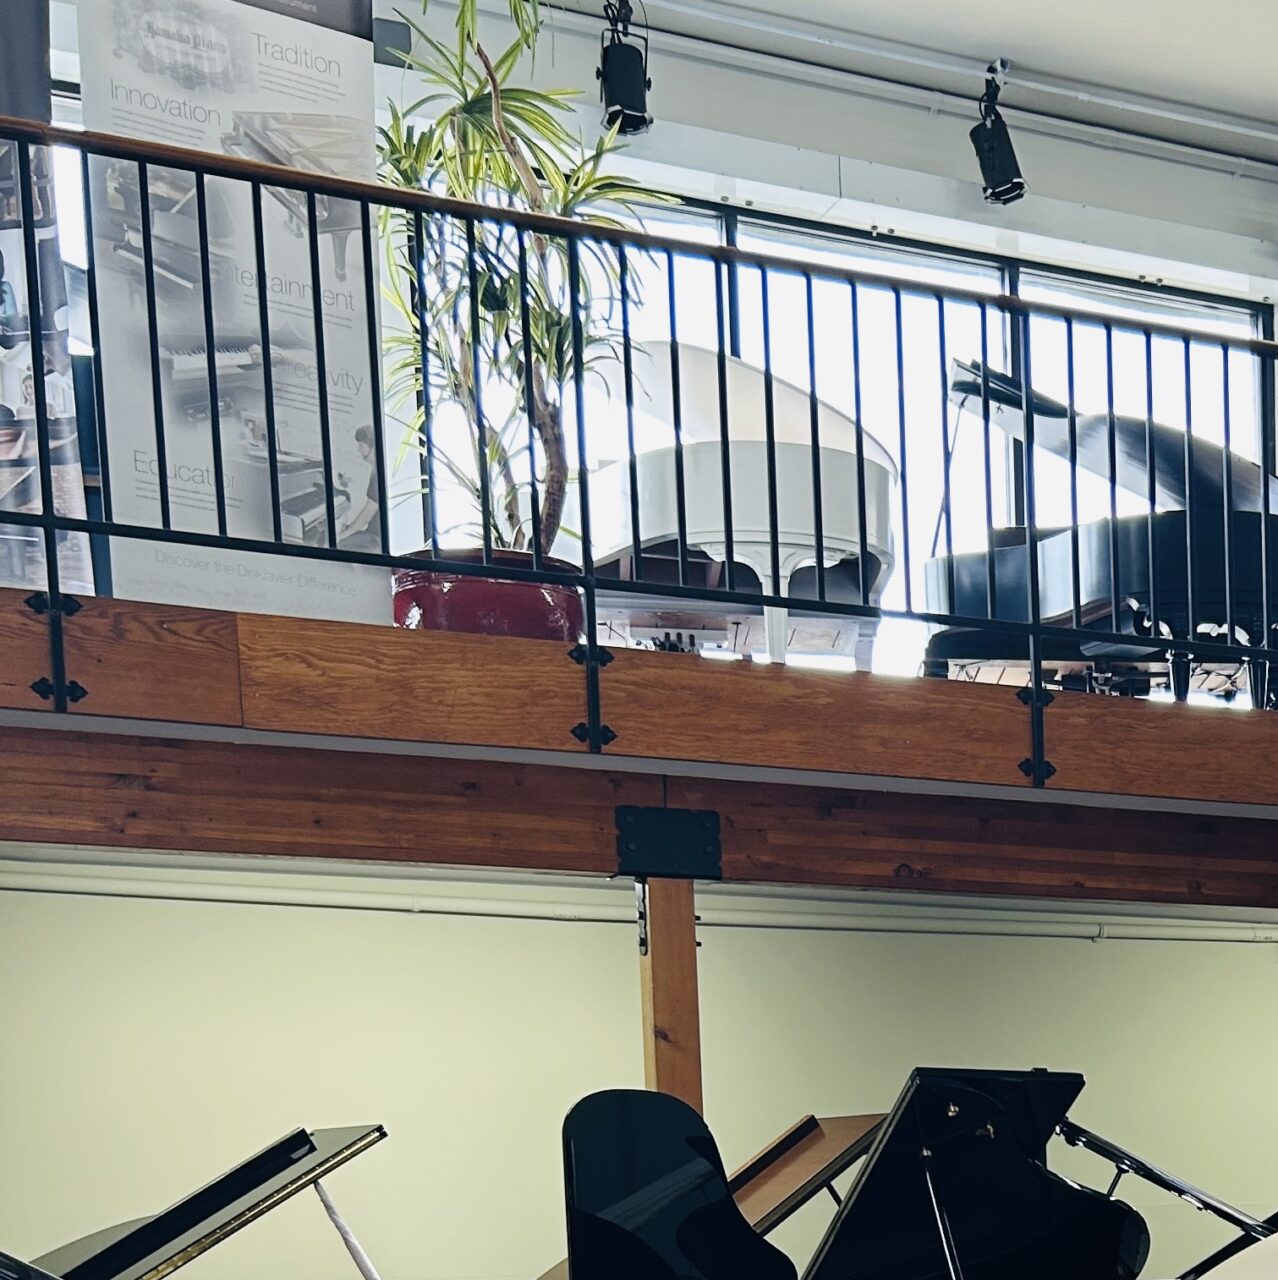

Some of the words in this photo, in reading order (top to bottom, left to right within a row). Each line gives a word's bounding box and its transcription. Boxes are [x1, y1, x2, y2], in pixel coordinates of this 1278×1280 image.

[251, 31, 341, 78] Tradition
[110, 77, 221, 127] Innovation
[133, 448, 244, 490] Educaton
[154, 549, 210, 571] Discover
[213, 559, 235, 576] the
